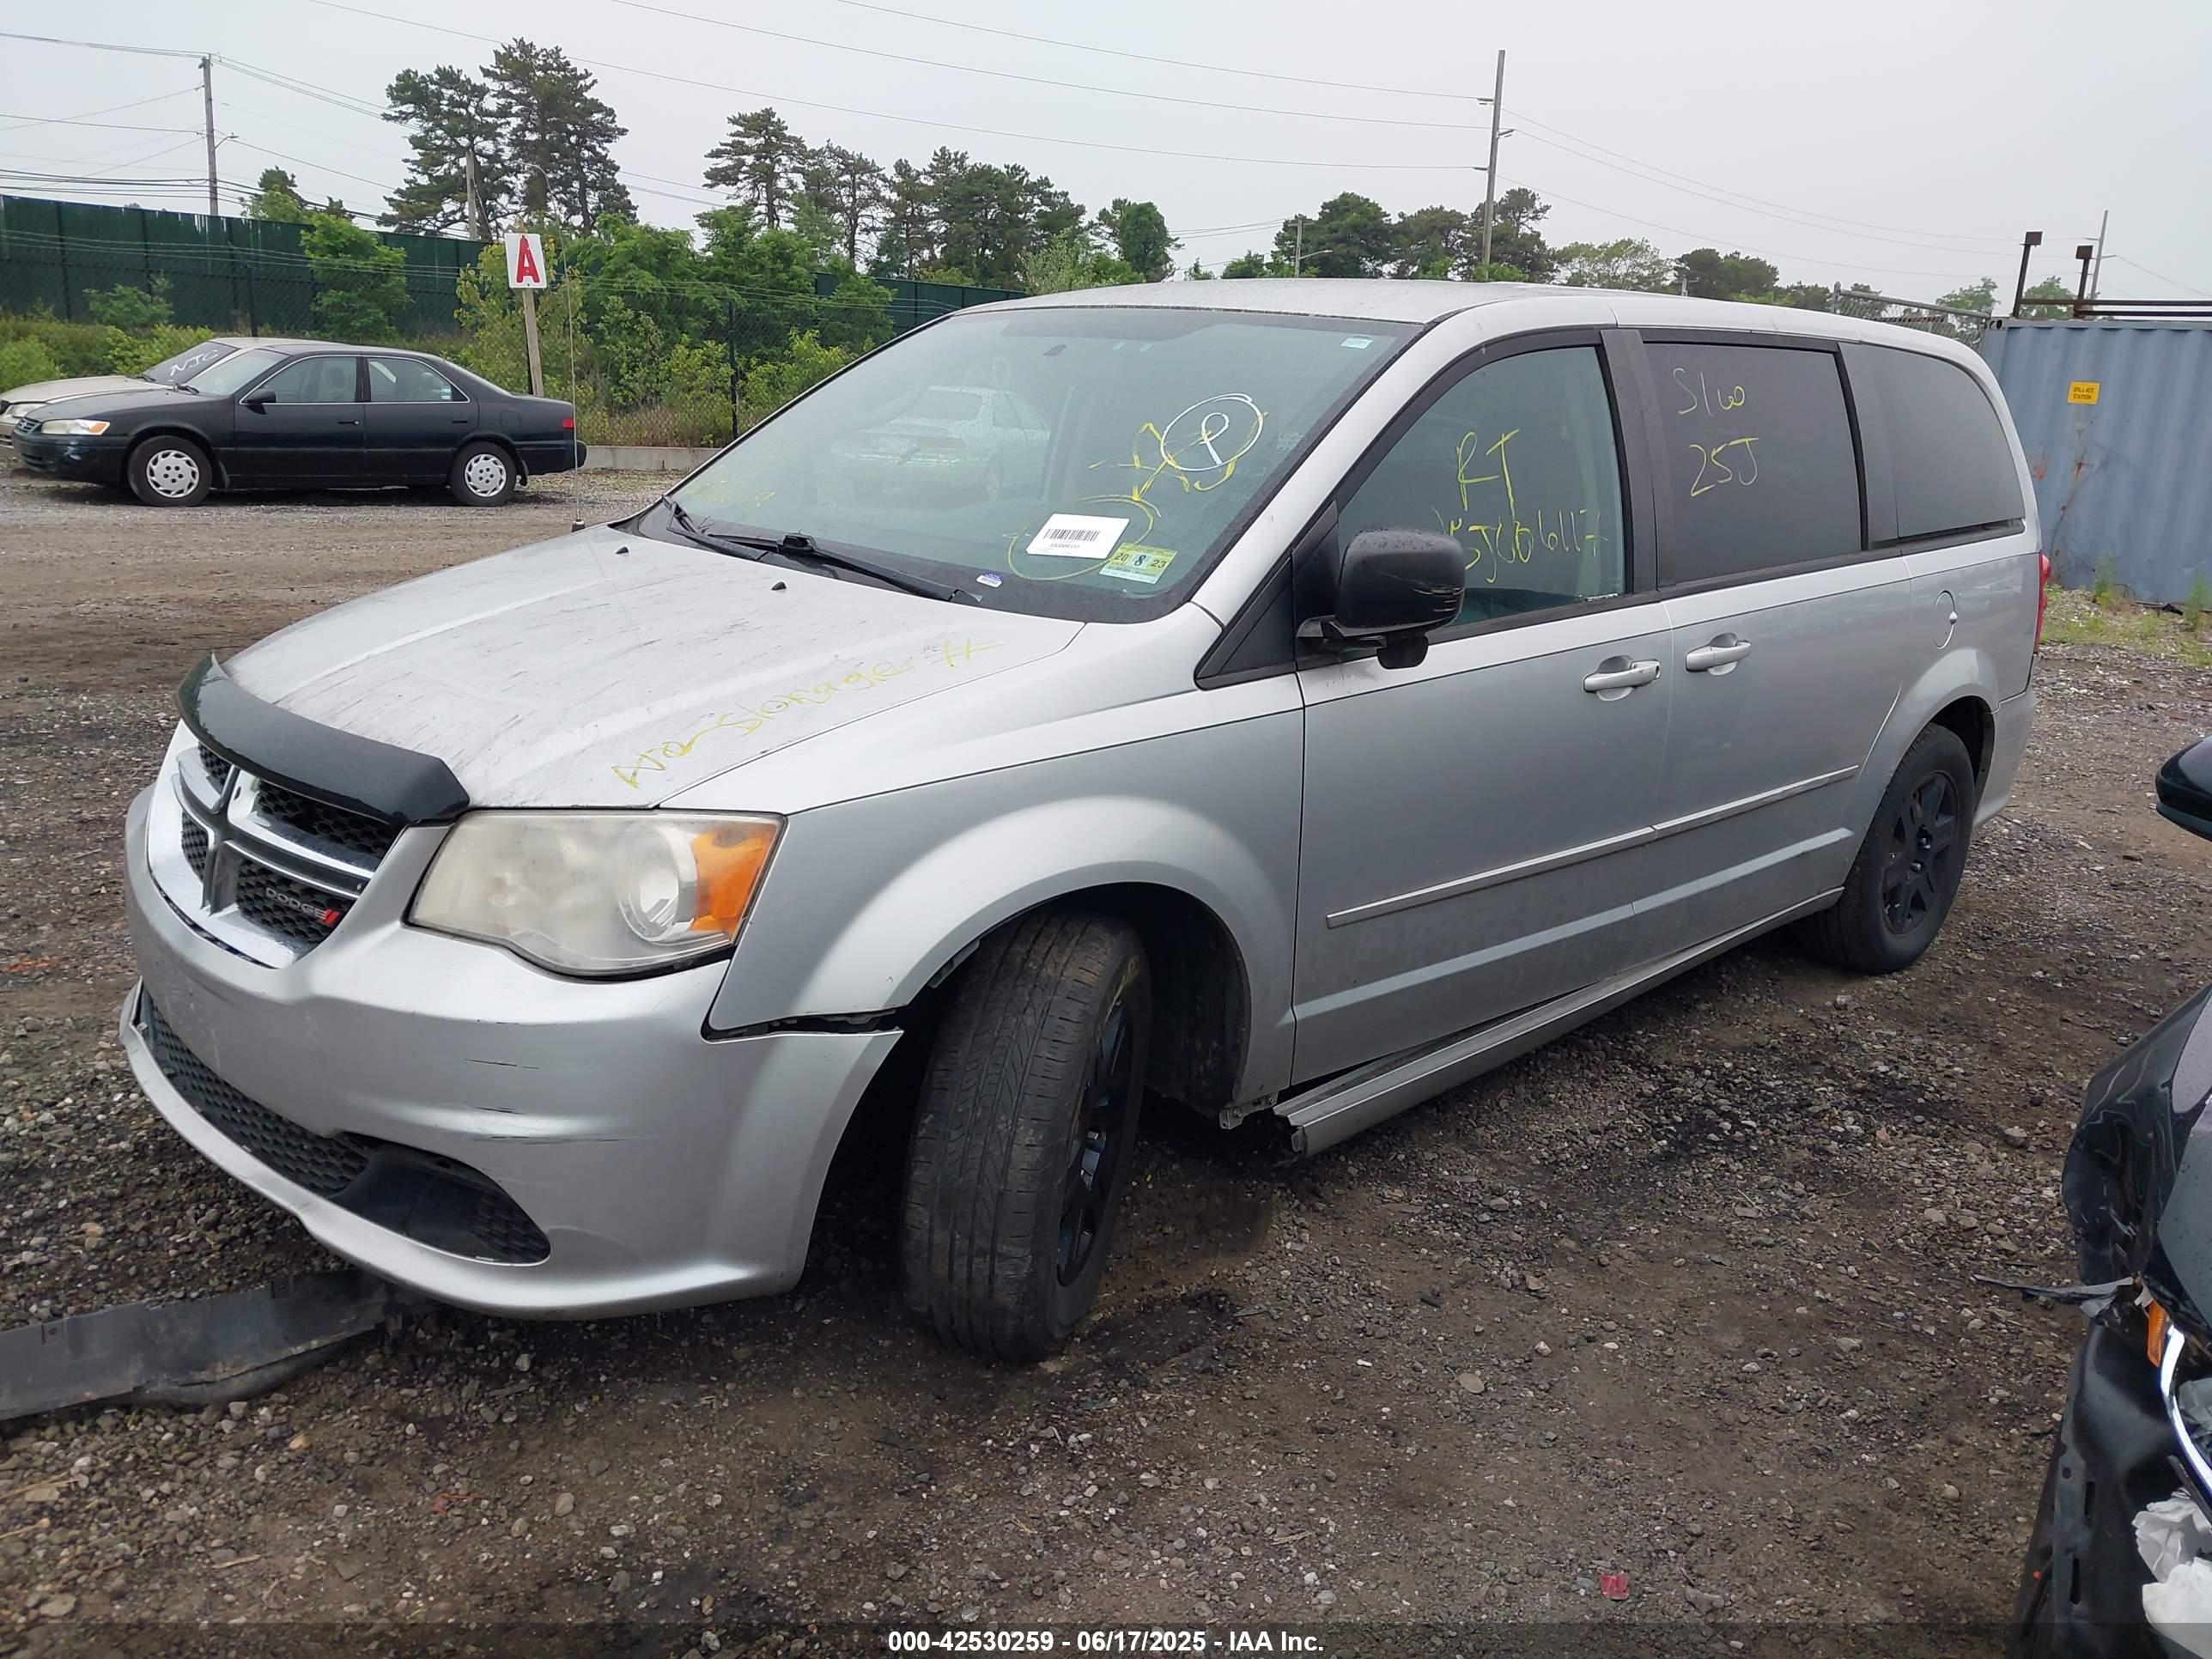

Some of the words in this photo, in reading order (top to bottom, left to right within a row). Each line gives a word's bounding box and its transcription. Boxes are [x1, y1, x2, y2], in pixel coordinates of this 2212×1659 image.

[516, 234, 540, 283] A
[1115, 552, 1130, 562] 20
[1133, 554, 1147, 568] 8
[1151, 559, 1167, 568] 23
[265, 886, 328, 921] DODGE
